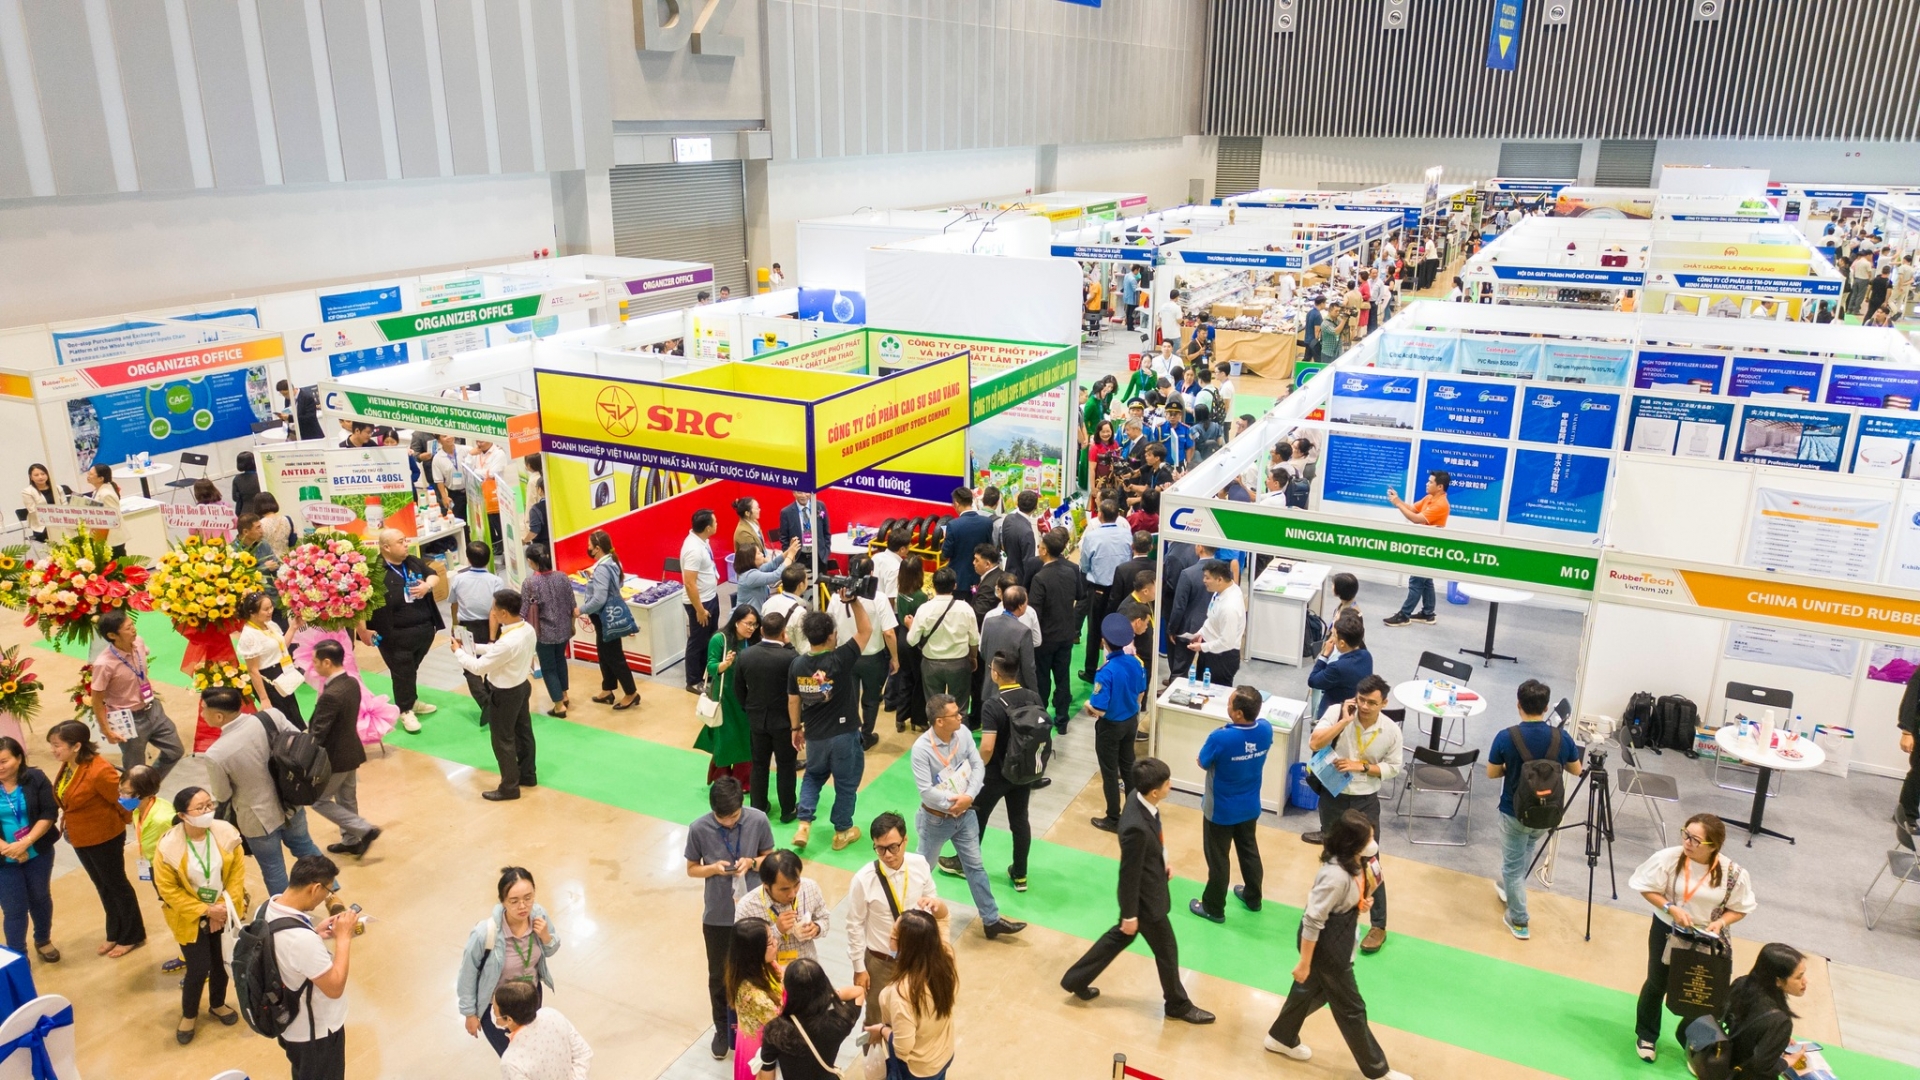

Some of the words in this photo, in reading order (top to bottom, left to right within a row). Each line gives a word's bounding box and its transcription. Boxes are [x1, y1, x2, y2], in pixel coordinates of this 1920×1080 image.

[643, 277, 675, 290] ORGANIZER
[676, 274, 693, 285] OFFICE
[414, 311, 477, 331] ORGANIZER
[478, 303, 514, 322] OFFICE
[801, 352, 810, 361] CP
[811, 348, 827, 359] SUPE
[845, 339, 861, 348] PHÁT
[823, 355, 837, 364] LÂM
[838, 350, 854, 359] THAO
[907, 337, 936, 348] CÔNG
[938, 341, 951, 349] TY
[970, 345, 996, 353] SUPE
[999, 345, 1025, 356] PHỐT
[920, 349, 934, 357] VÀ
[990, 355, 1012, 363] LÂM
[127, 355, 200, 377] ORGANIZER
[202, 349, 243, 365] OFFICE
[367, 396, 396, 407] VIETNAM
[397, 400, 429, 412] PESTICIDE
[430, 404, 449, 415] JOINT
[450, 408, 472, 417] STOCK
[472, 410, 506, 422] COMPANY
[828, 424, 851, 444] CÔNG
[852, 418, 864, 435] TY
[865, 403, 877, 430] CỔ
[878, 401, 899, 427] PHẦN
[901, 398, 915, 416] CAO
[917, 393, 927, 409] SU
[928, 390, 942, 405] SAO
[943, 381, 960, 399] VÀNG
[364, 407, 382, 417] CÔNG
[382, 411, 391, 419] TY
[480, 422, 494, 436] VIỆT
[497, 427, 507, 435] NA
[647, 404, 733, 439] SRC
[841, 443, 854, 458] SAO
[855, 438, 870, 453] VANG
[871, 429, 894, 447] RUBBER
[894, 423, 910, 438] JOINT
[910, 416, 928, 433] STOCK
[928, 406, 951, 428] COMPANY
[281, 467, 316, 476] ANTIBA
[551, 440, 578, 452] DOANH
[578, 443, 605, 457] NGHIỆP
[606, 447, 622, 461] VIỆT
[623, 450, 641, 461] NAM
[642, 452, 658, 464] DUY
[660, 455, 680, 467] NHẤT
[681, 456, 697, 471] SẢN
[699, 460, 719, 473] XUẤT
[720, 464, 744, 480] ĐƯỢC
[745, 467, 760, 481] LỐP
[761, 471, 780, 484] MÁY
[782, 474, 799, 486] BAY
[333, 475, 373, 485] BETAZOL
[376, 473, 404, 482] 480SL
[856, 473, 876, 488] con
[877, 474, 911, 496] đường
[1285, 527, 1335, 544] NINGXIA
[1336, 533, 1388, 552] TAIYICIN
[1389, 541, 1444, 559] BIOTECH
[1446, 549, 1471, 564] CO.,
[1473, 553, 1499, 567] LTD.
[1560, 565, 1590, 581] M10
[1609, 570, 1674, 586] RubberTech
[1625, 583, 1655, 593] Vietnam
[1747, 590, 1798, 610] CHINA
[1802, 594, 1863, 618] UNITED
[1866, 608, 1920, 627] RUBBE
